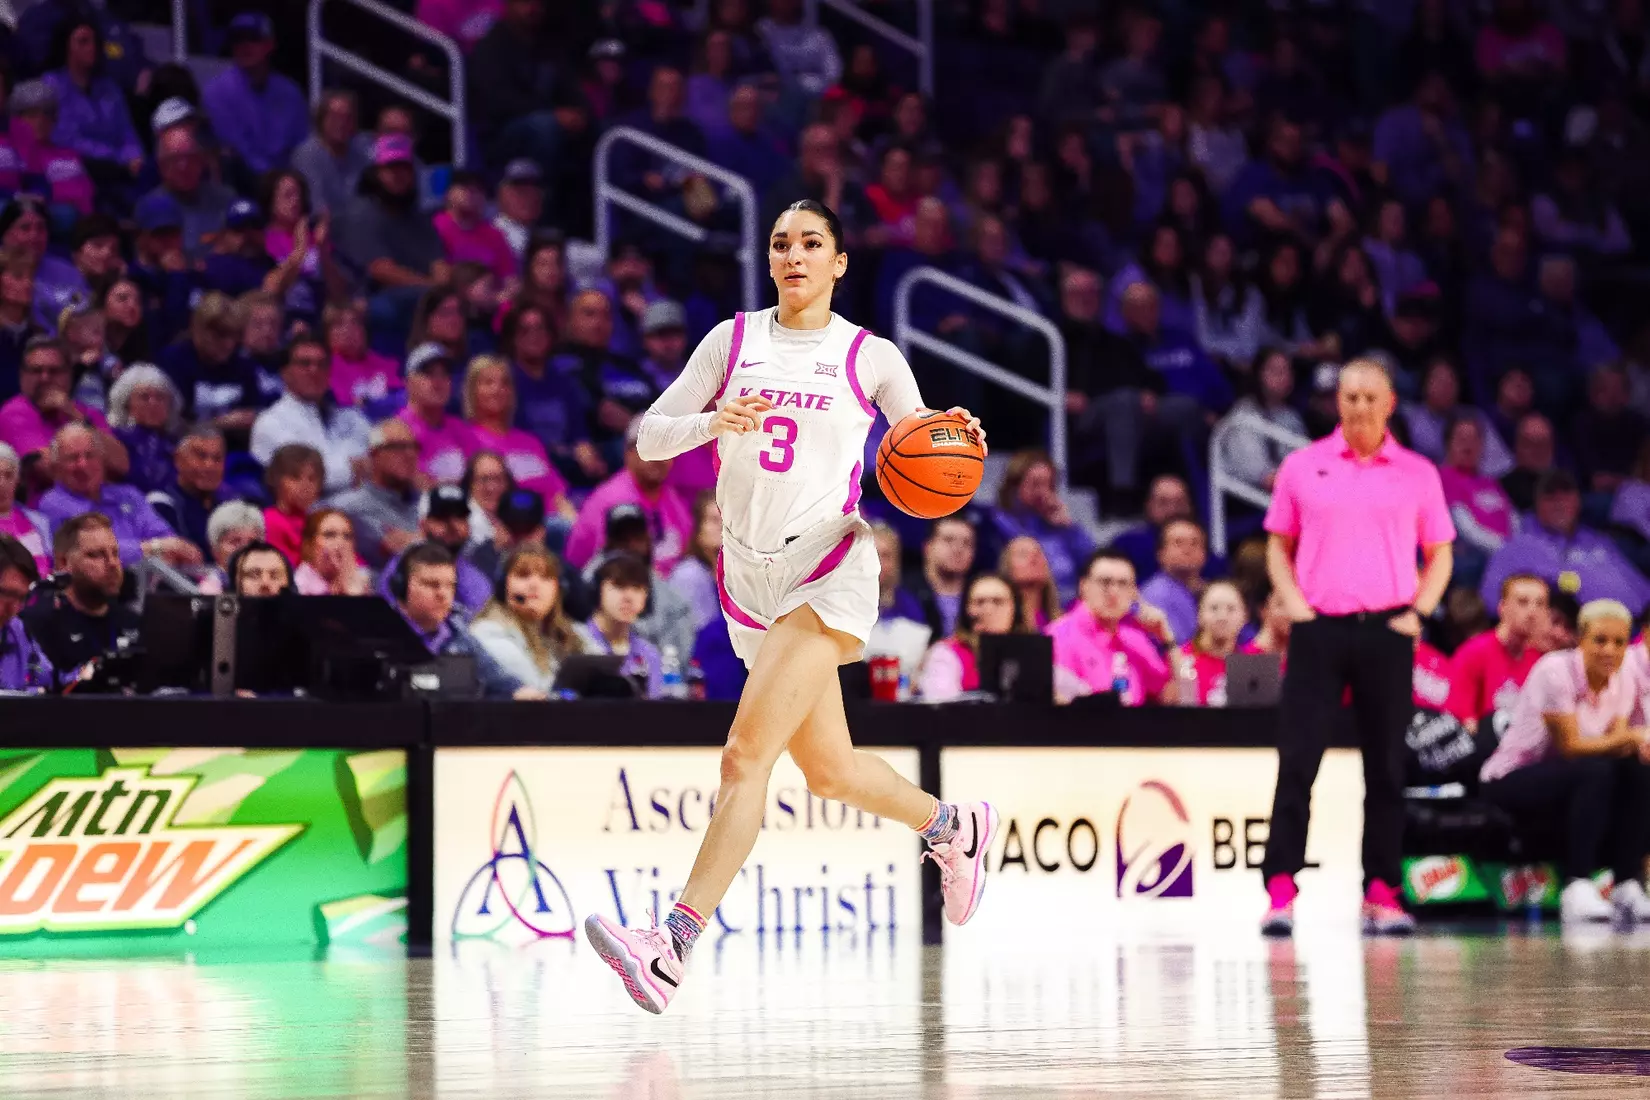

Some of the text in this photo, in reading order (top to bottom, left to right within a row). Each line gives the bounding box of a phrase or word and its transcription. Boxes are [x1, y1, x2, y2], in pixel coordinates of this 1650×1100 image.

[740, 387, 833, 411] KSTATE
[759, 416, 798, 473] 3
[3, 780, 173, 838] Mtn
[602, 767, 881, 831] Ascsio
[984, 817, 1320, 873] ACO BE
